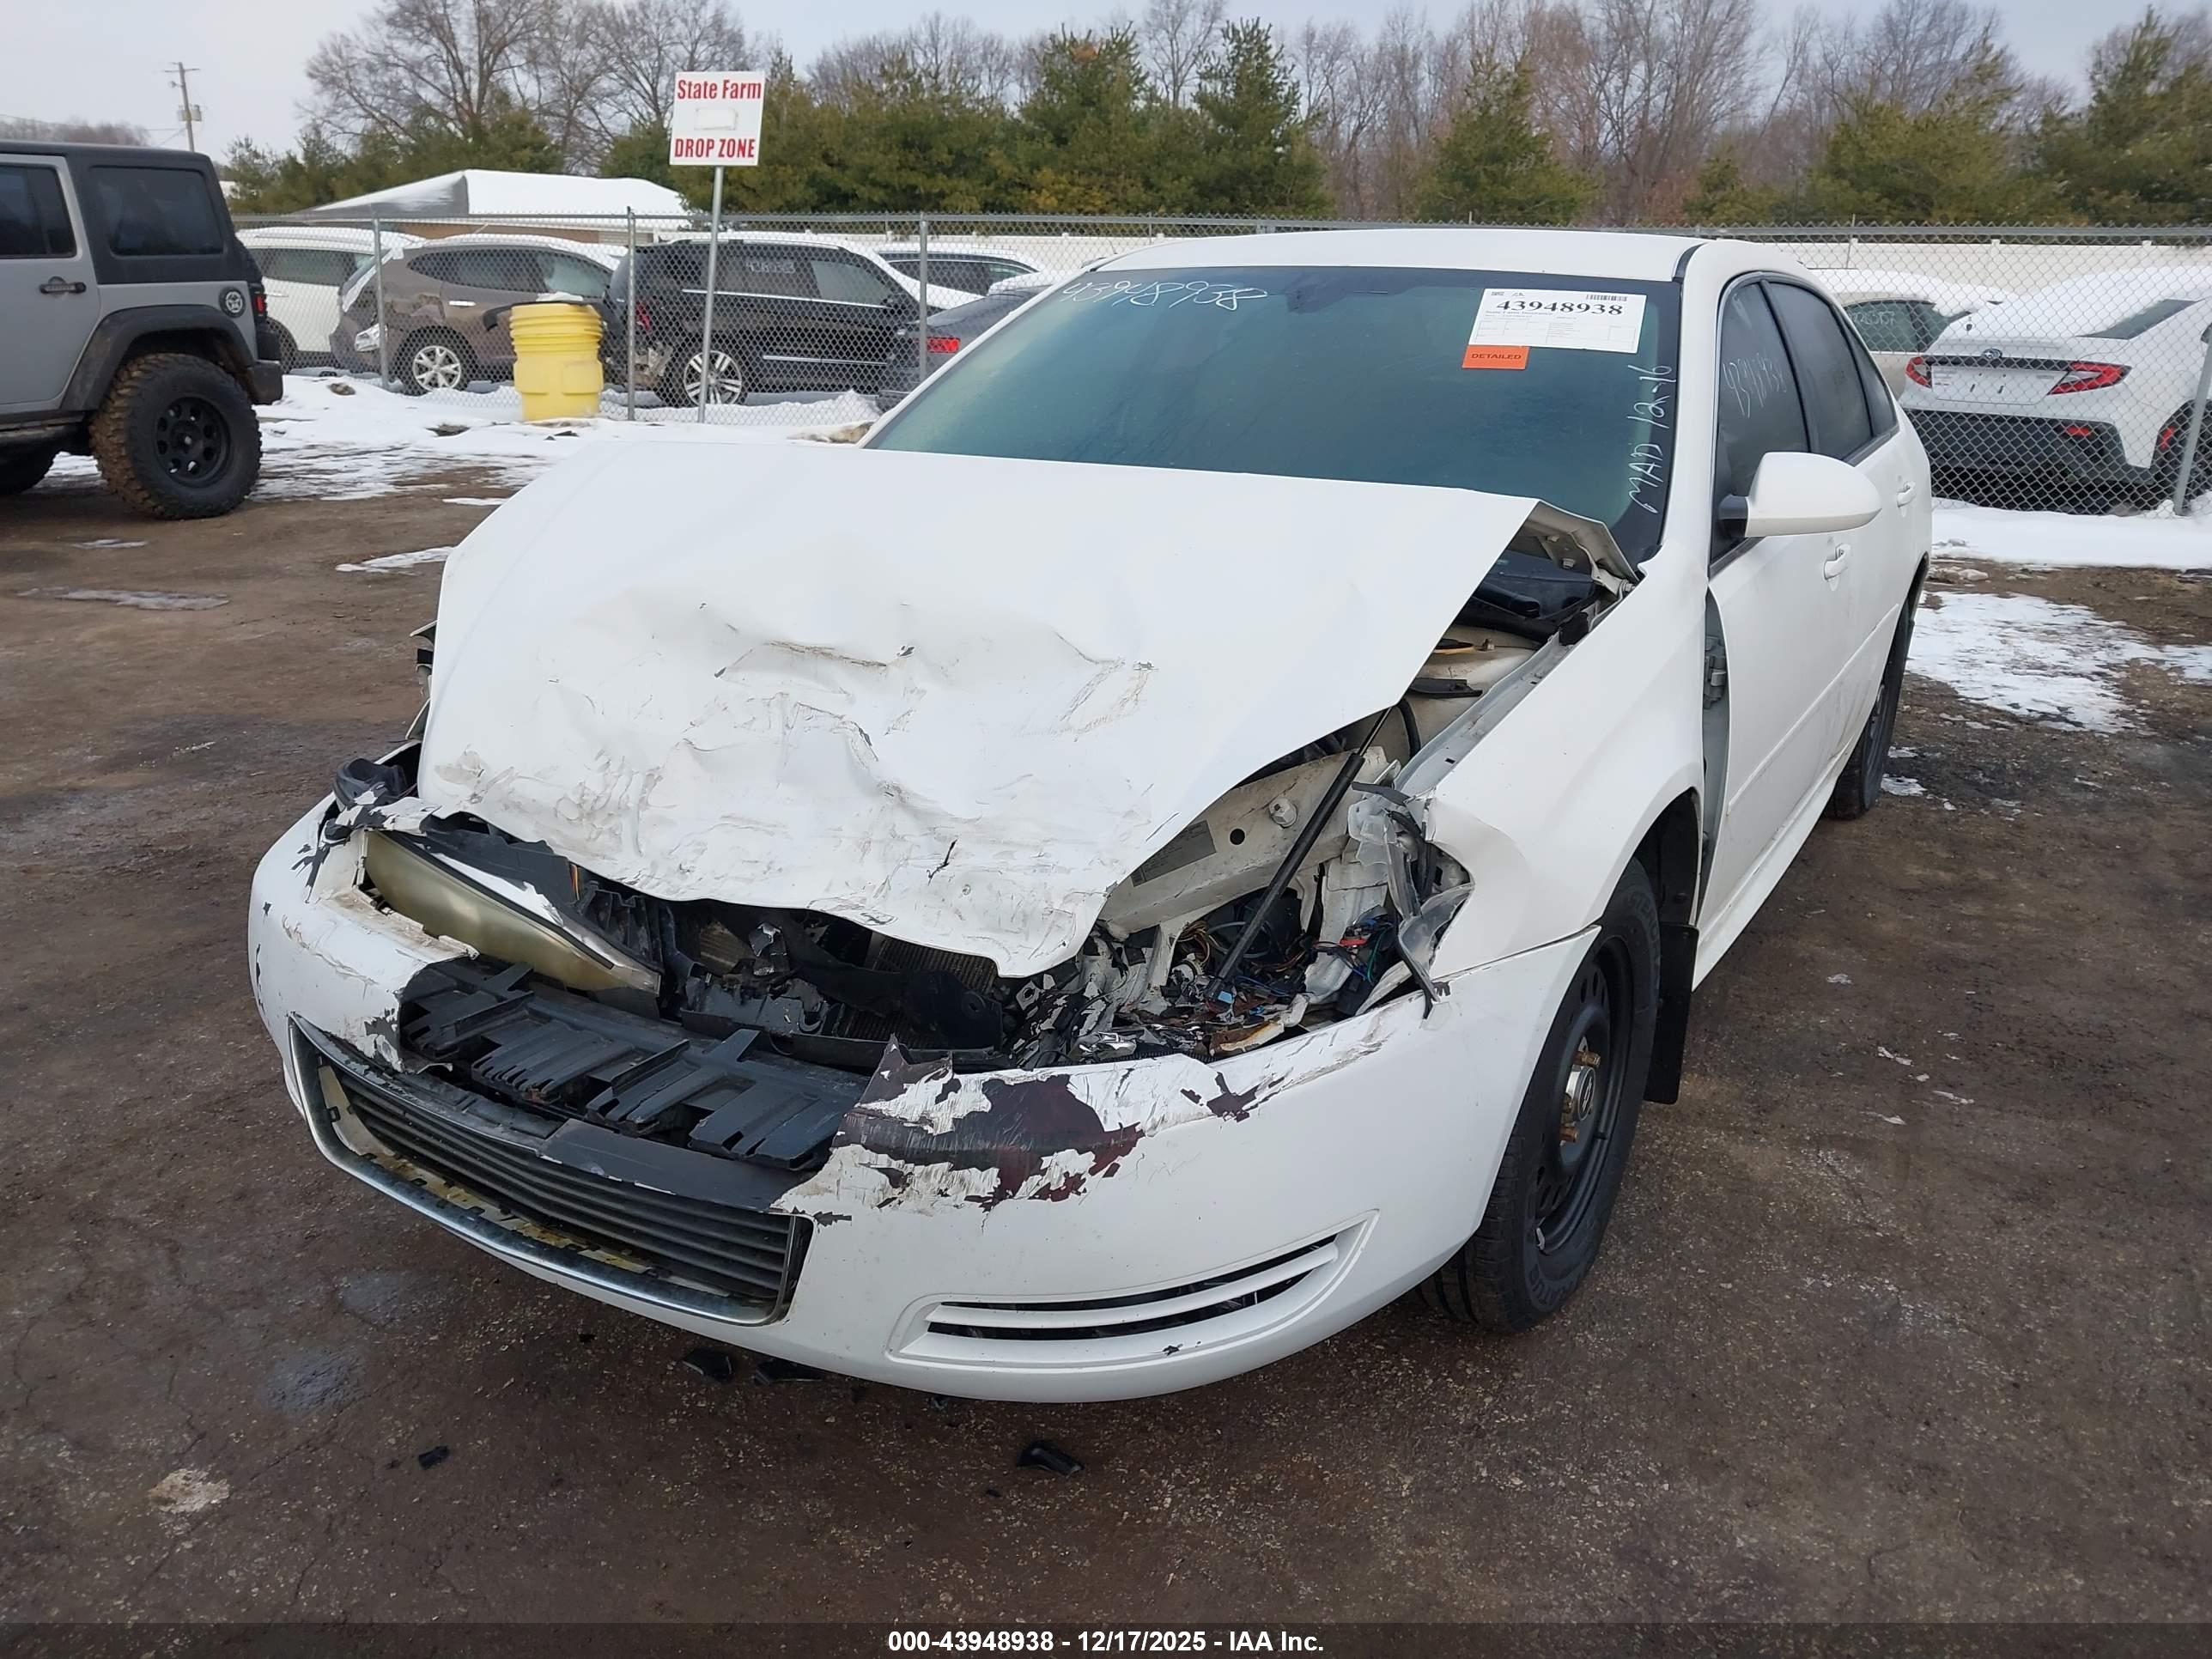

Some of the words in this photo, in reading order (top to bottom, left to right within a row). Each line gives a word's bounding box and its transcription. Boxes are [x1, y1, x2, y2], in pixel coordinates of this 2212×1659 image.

[678, 79, 718, 100] State
[721, 79, 762, 100] Farm
[674, 138, 714, 158] DROP
[718, 138, 756, 158] ZONE
[1496, 300, 1624, 316] 43948938
